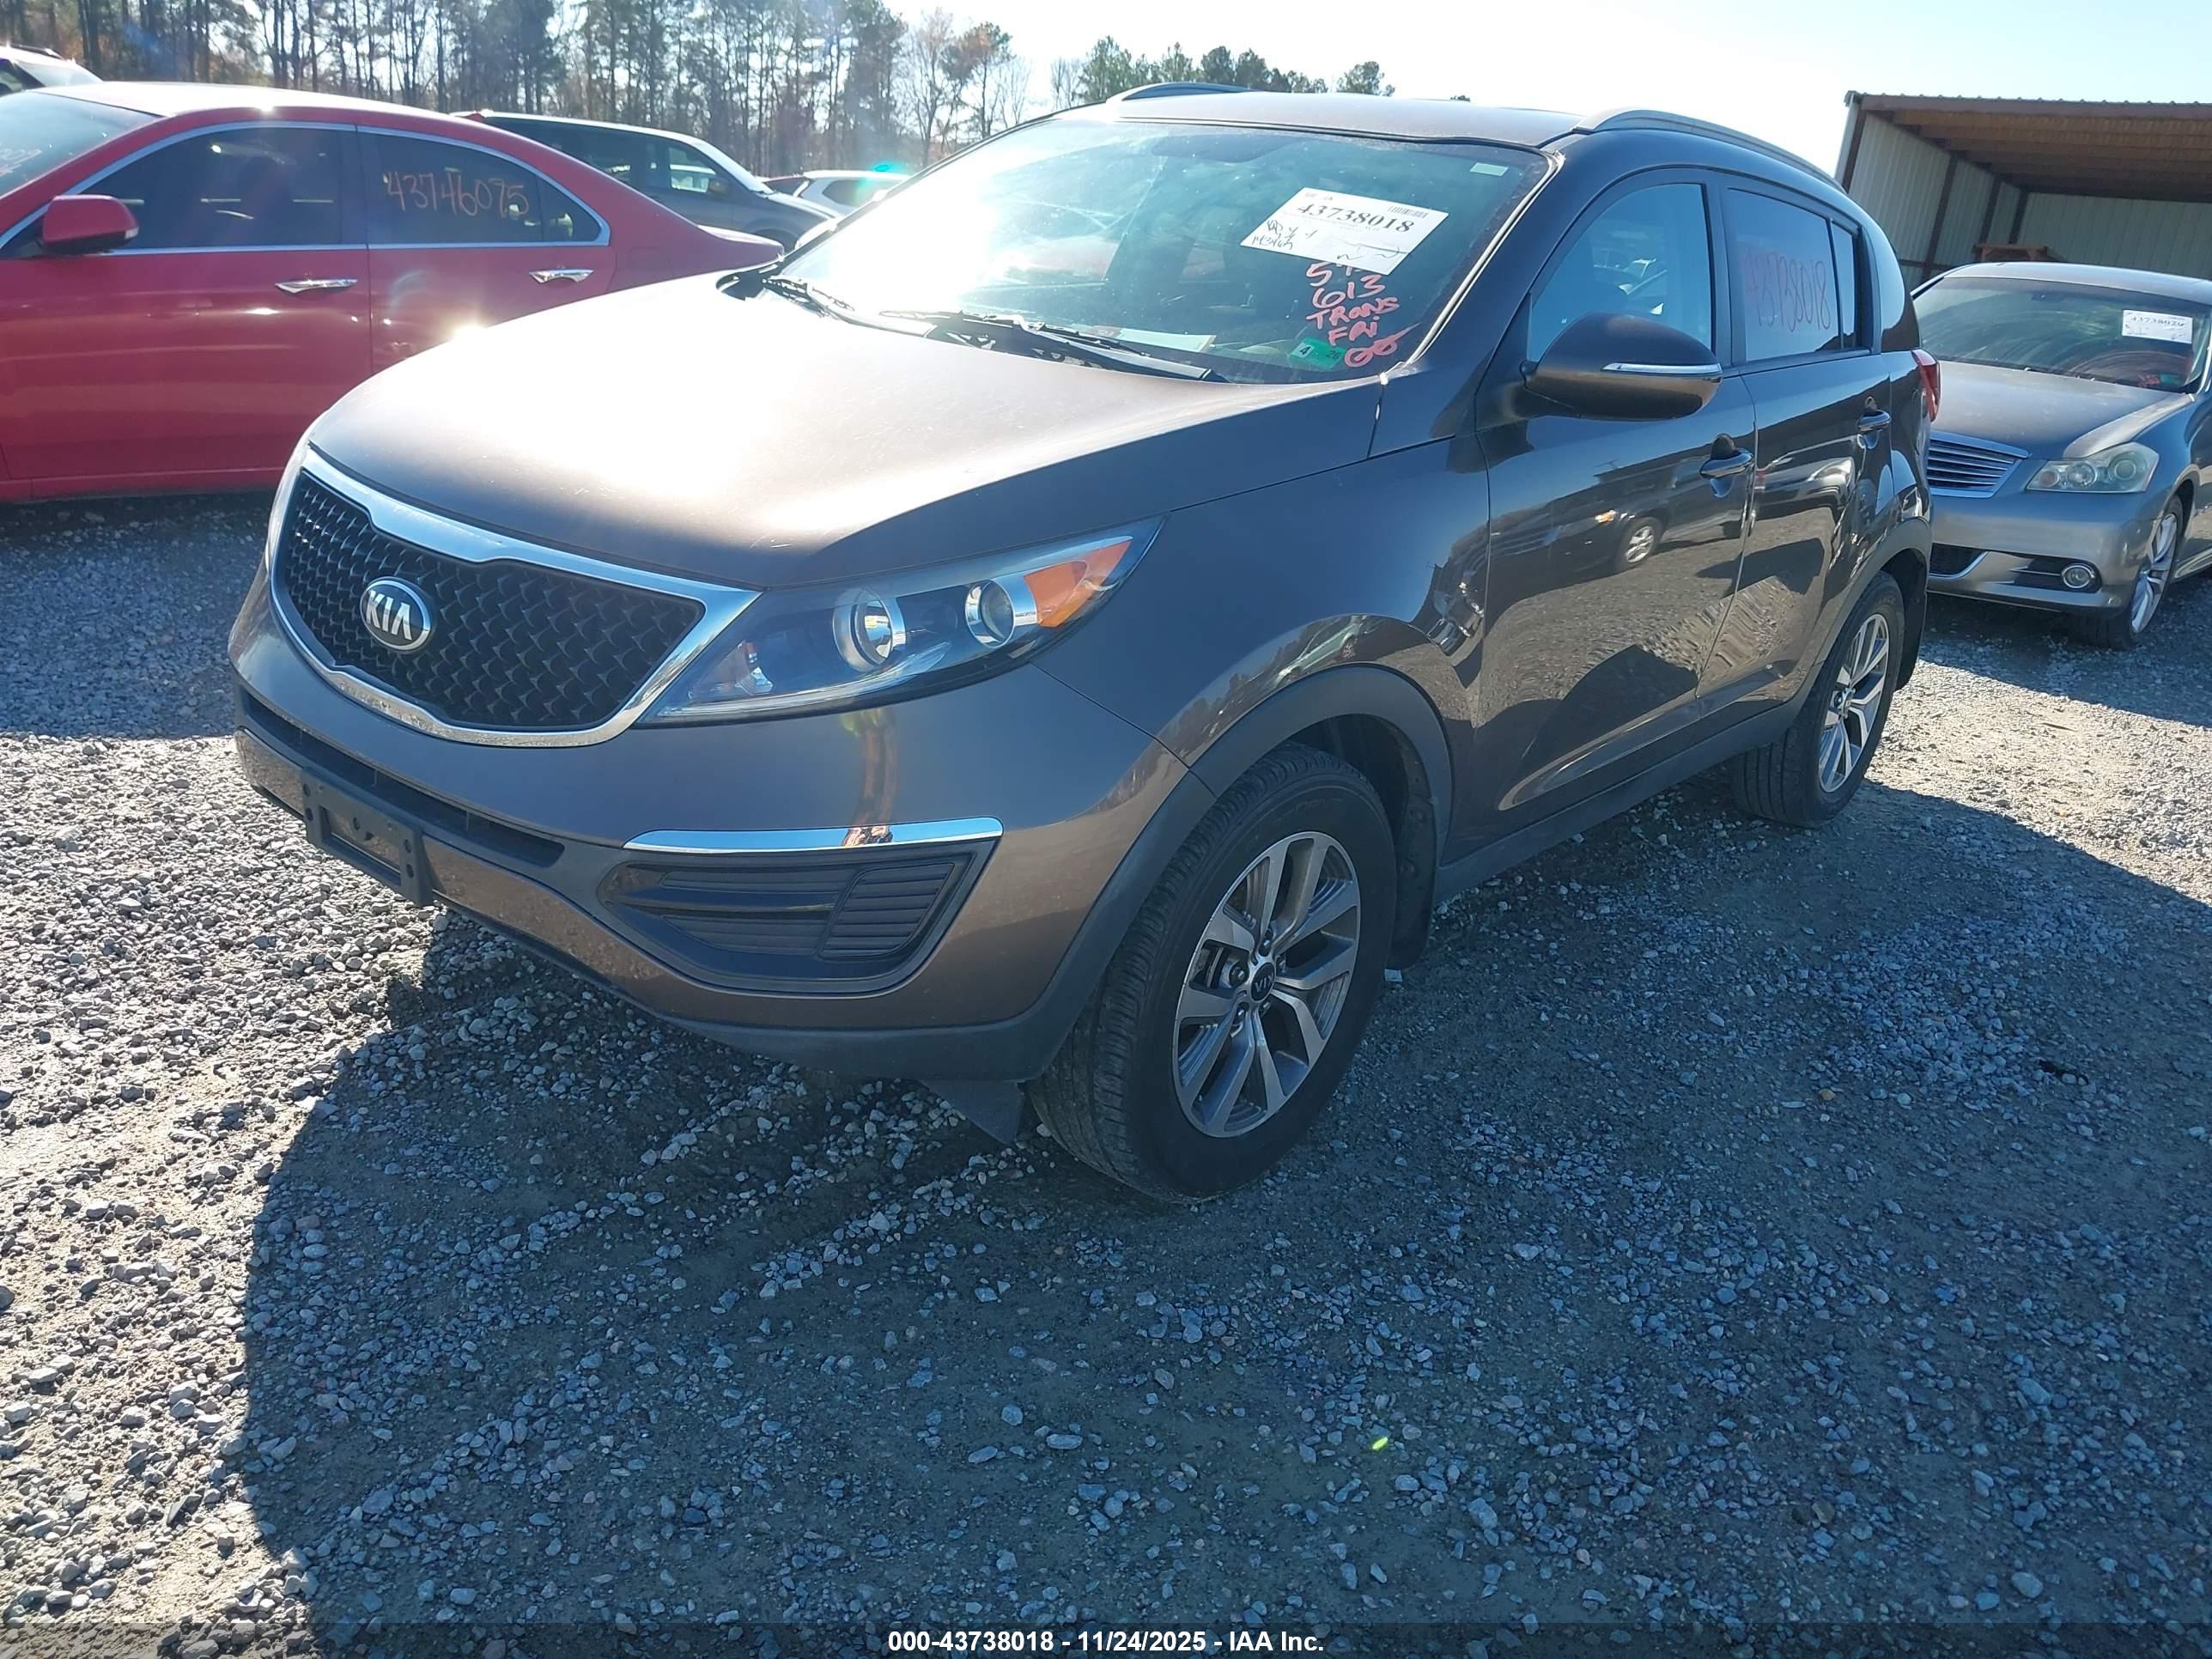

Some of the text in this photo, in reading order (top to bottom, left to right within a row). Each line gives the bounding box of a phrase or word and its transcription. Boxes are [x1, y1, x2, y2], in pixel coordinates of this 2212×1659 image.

[386, 171, 529, 217] 43746075
[1297, 204, 1414, 233] 43738018
[366, 590, 412, 641] KIA
